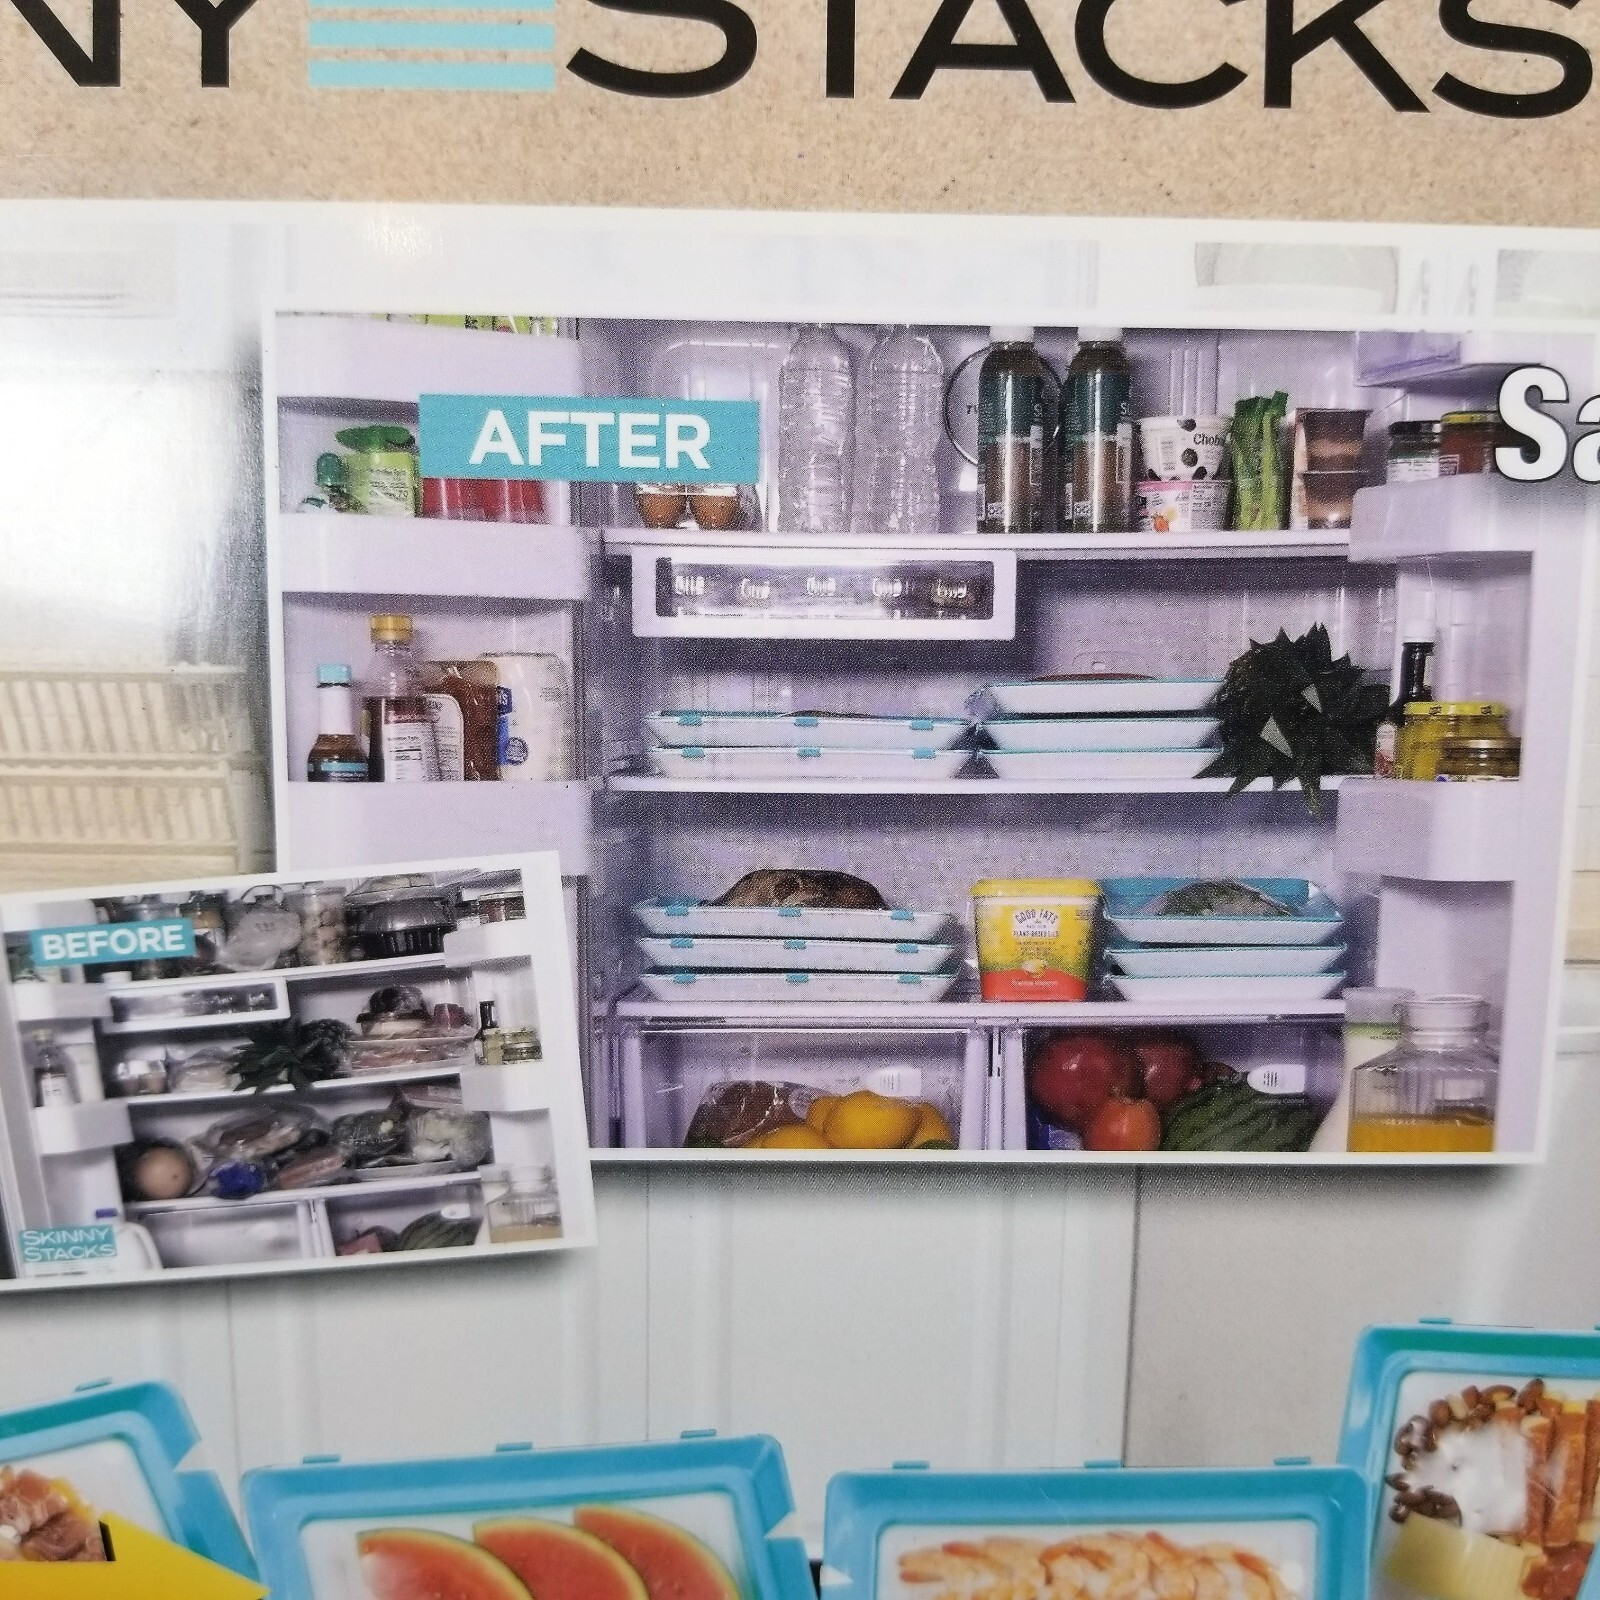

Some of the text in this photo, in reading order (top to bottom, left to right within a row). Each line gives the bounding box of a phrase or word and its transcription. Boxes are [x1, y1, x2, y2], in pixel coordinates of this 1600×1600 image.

[468, 409, 712, 470] AFTER
[40, 924, 186, 961] BEFORE
[23, 1227, 110, 1246] SKINNY
[24, 1243, 116, 1262] STACKS
